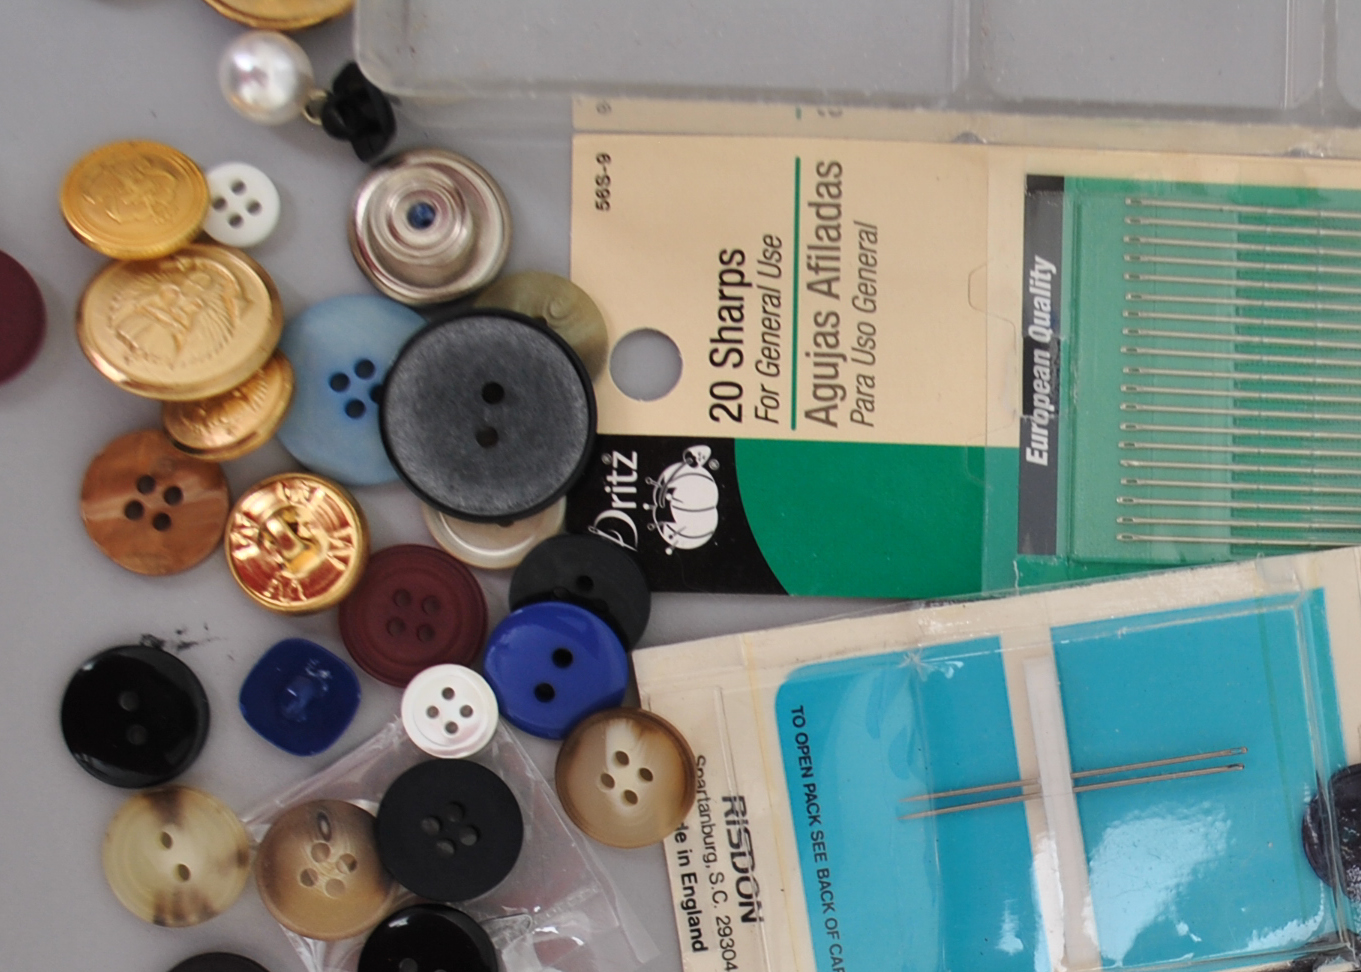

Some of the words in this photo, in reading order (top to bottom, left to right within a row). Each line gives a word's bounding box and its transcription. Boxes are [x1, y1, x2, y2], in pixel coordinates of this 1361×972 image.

[594, 152, 612, 212] 56S-9
[757, 233, 783, 279] Use
[805, 160, 843, 301] Afiladas
[852, 219, 879, 314] General
[709, 248, 753, 369] Sharps
[1028, 254, 1058, 343] Quality
[755, 285, 782, 378] General
[851, 321, 877, 367] Uso
[804, 310, 848, 428] Agujas
[709, 381, 743, 424] 20
[755, 383, 780, 424] For
[850, 372, 876, 428] Para
[1025, 343, 1060, 467] European
[790, 704, 806, 729] TO
[795, 731, 814, 778] OPEN
[802, 782, 822, 827] PACK
[676, 848, 693, 867] in
[722, 794, 765, 924] RISDON
[810, 830, 828, 863] SEE
[680, 871, 709, 953] England
[708, 871, 729, 909] S.C.
[815, 867, 836, 914] BACK
[715, 915, 739, 972] 29304
[824, 917, 841, 941] OF
